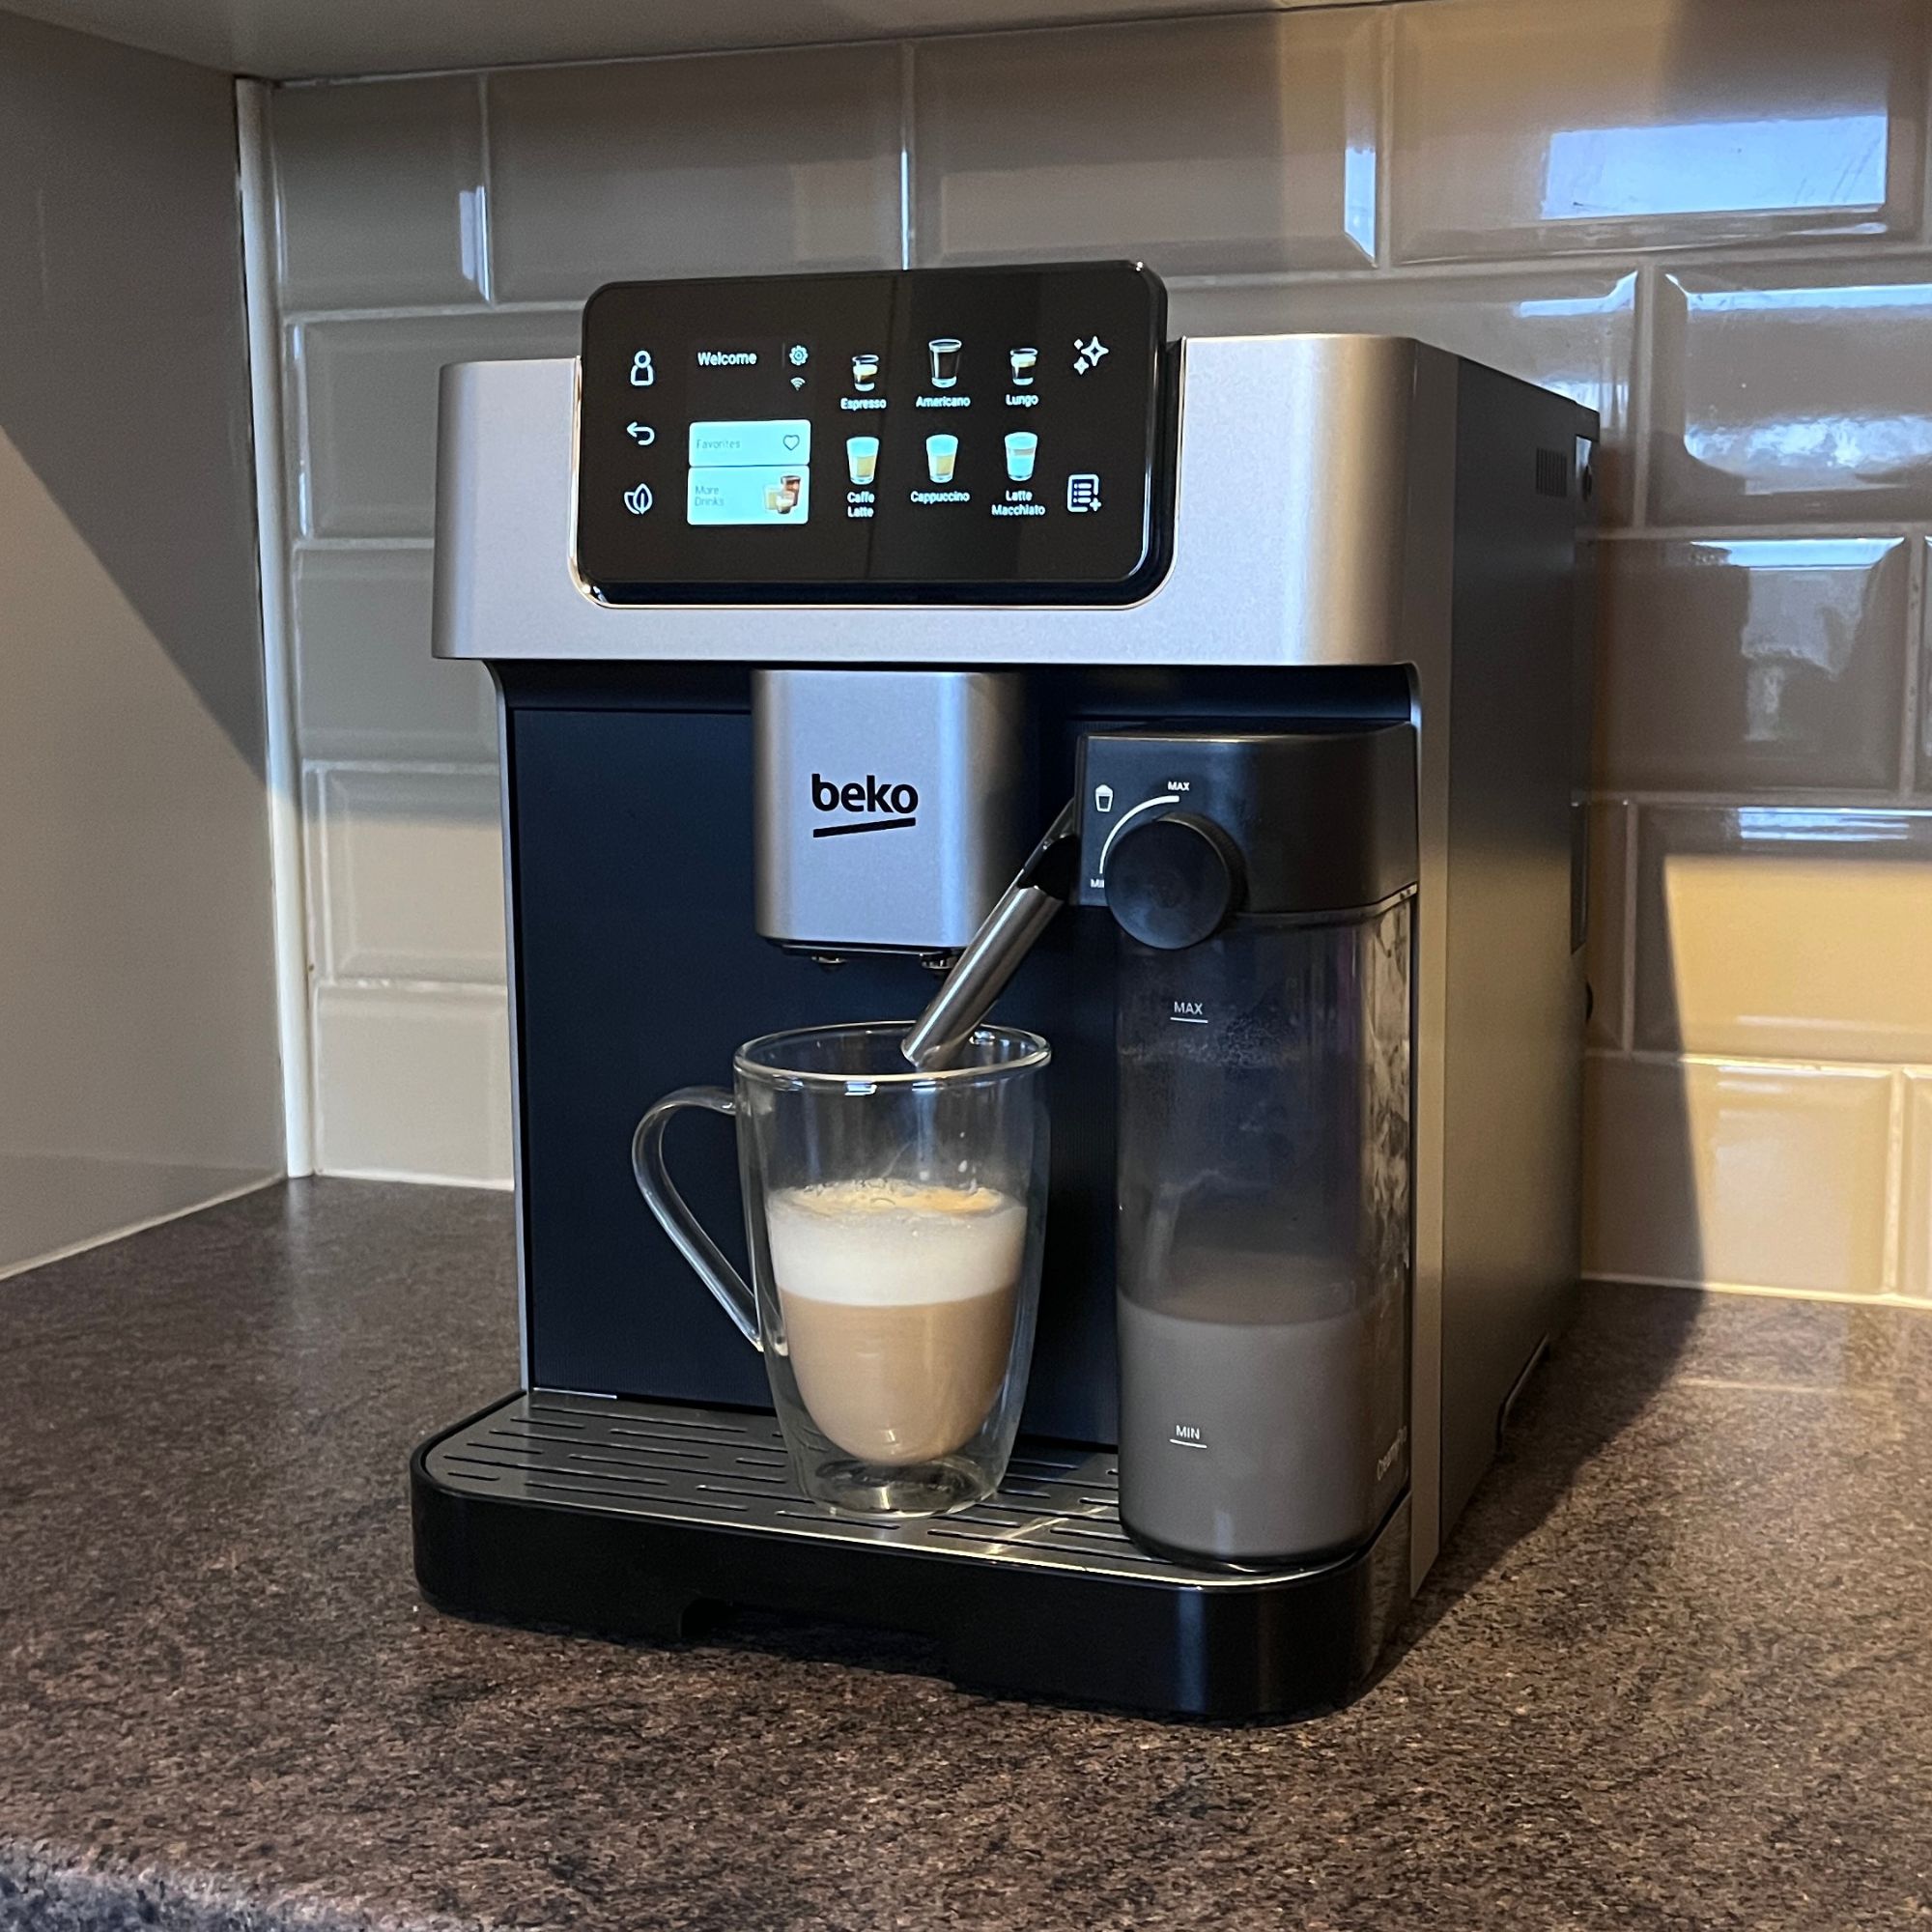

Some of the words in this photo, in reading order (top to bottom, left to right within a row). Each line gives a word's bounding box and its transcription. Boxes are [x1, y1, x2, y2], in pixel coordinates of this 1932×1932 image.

[697, 352, 757, 366] Welcome
[840, 397, 887, 411] Espresso
[916, 396, 971, 408] Americano
[1006, 394, 1039, 408] Lungo
[696, 439, 741, 449] Favorites
[696, 485, 720, 496] More
[1006, 490, 1033, 501] Latte
[695, 496, 724, 507] Drinks
[910, 491, 970, 504] Cappuccino
[847, 506, 874, 518] Latte
[991, 504, 1045, 516] Macchiato
[1167, 781, 1190, 792] MAX
[811, 773, 919, 814] beko
[1090, 878, 1105, 889] MI
[1174, 1001, 1204, 1015] MAX
[1176, 1424, 1201, 1440] MIN
